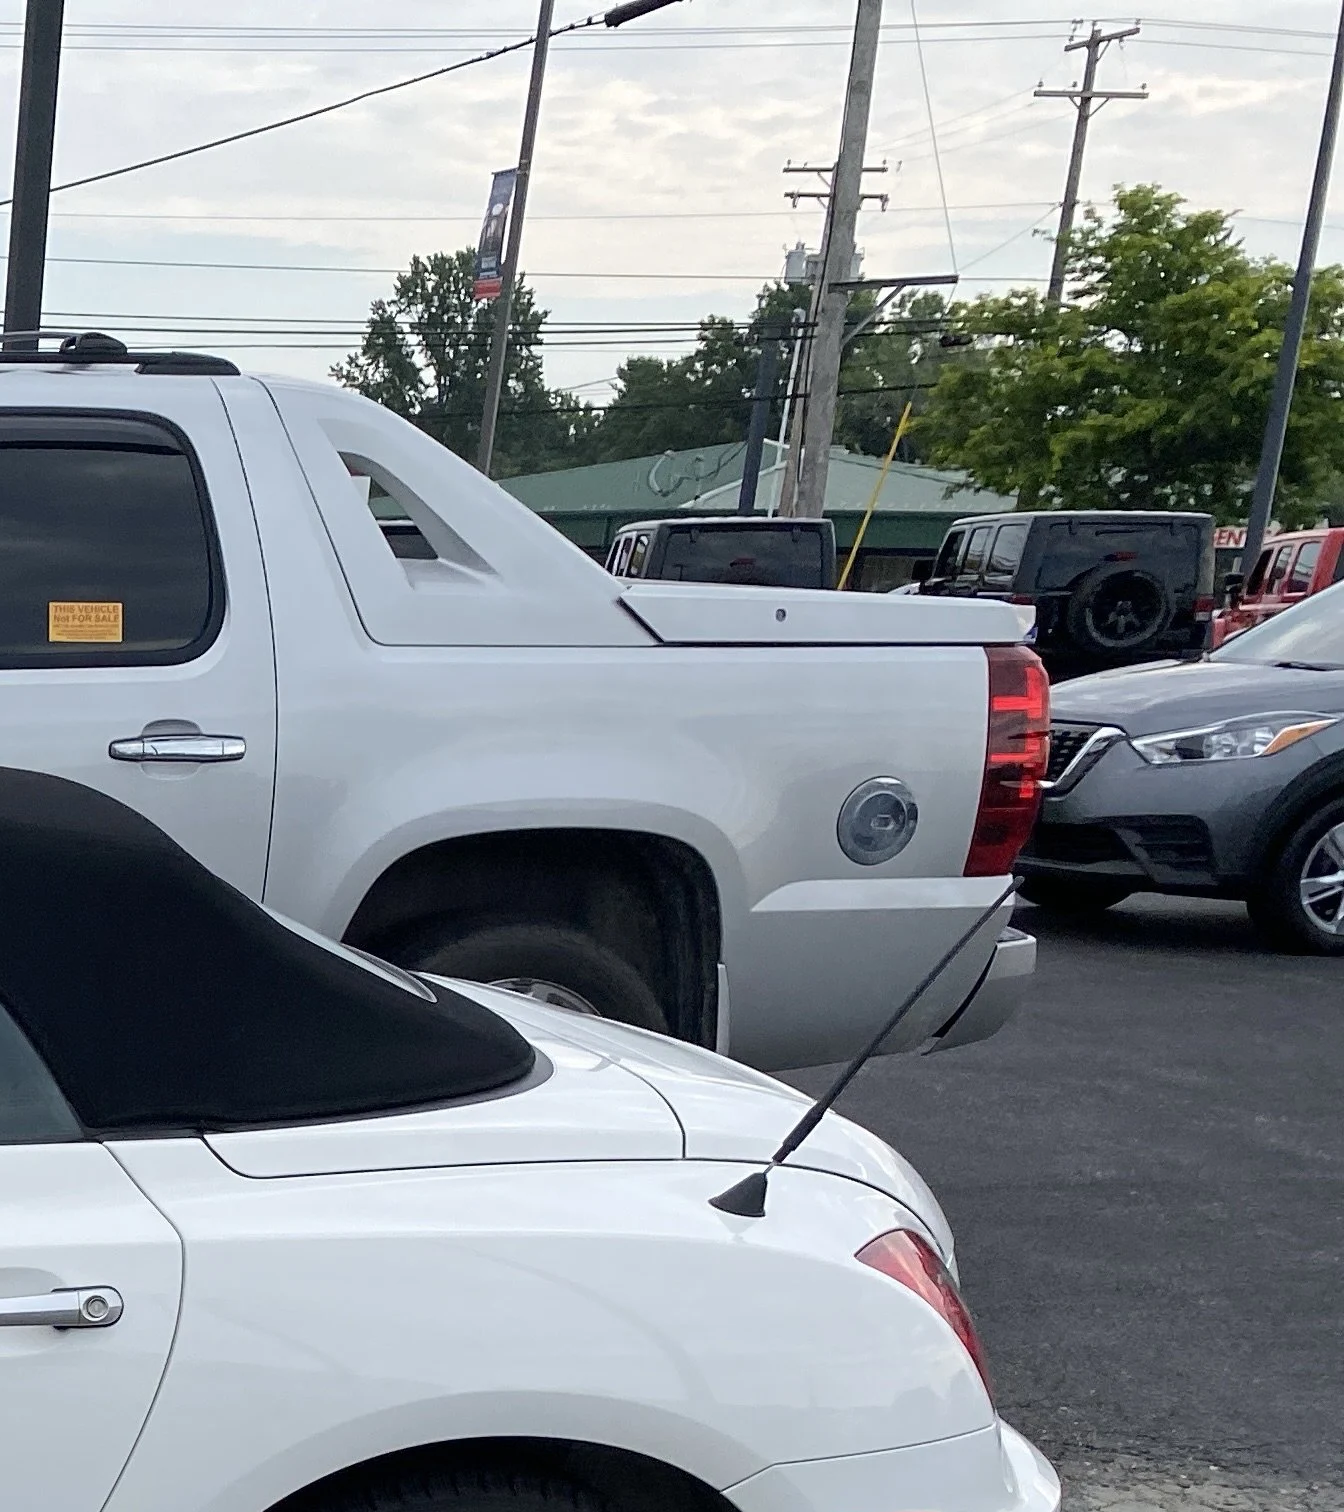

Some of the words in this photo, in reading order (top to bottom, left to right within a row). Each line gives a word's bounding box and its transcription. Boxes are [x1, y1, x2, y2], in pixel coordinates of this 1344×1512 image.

[53, 604, 75, 613] THIS
[78, 604, 119, 613] VEHICLE
[72, 614, 93, 622] FOR
[95, 614, 119, 622] SALE
